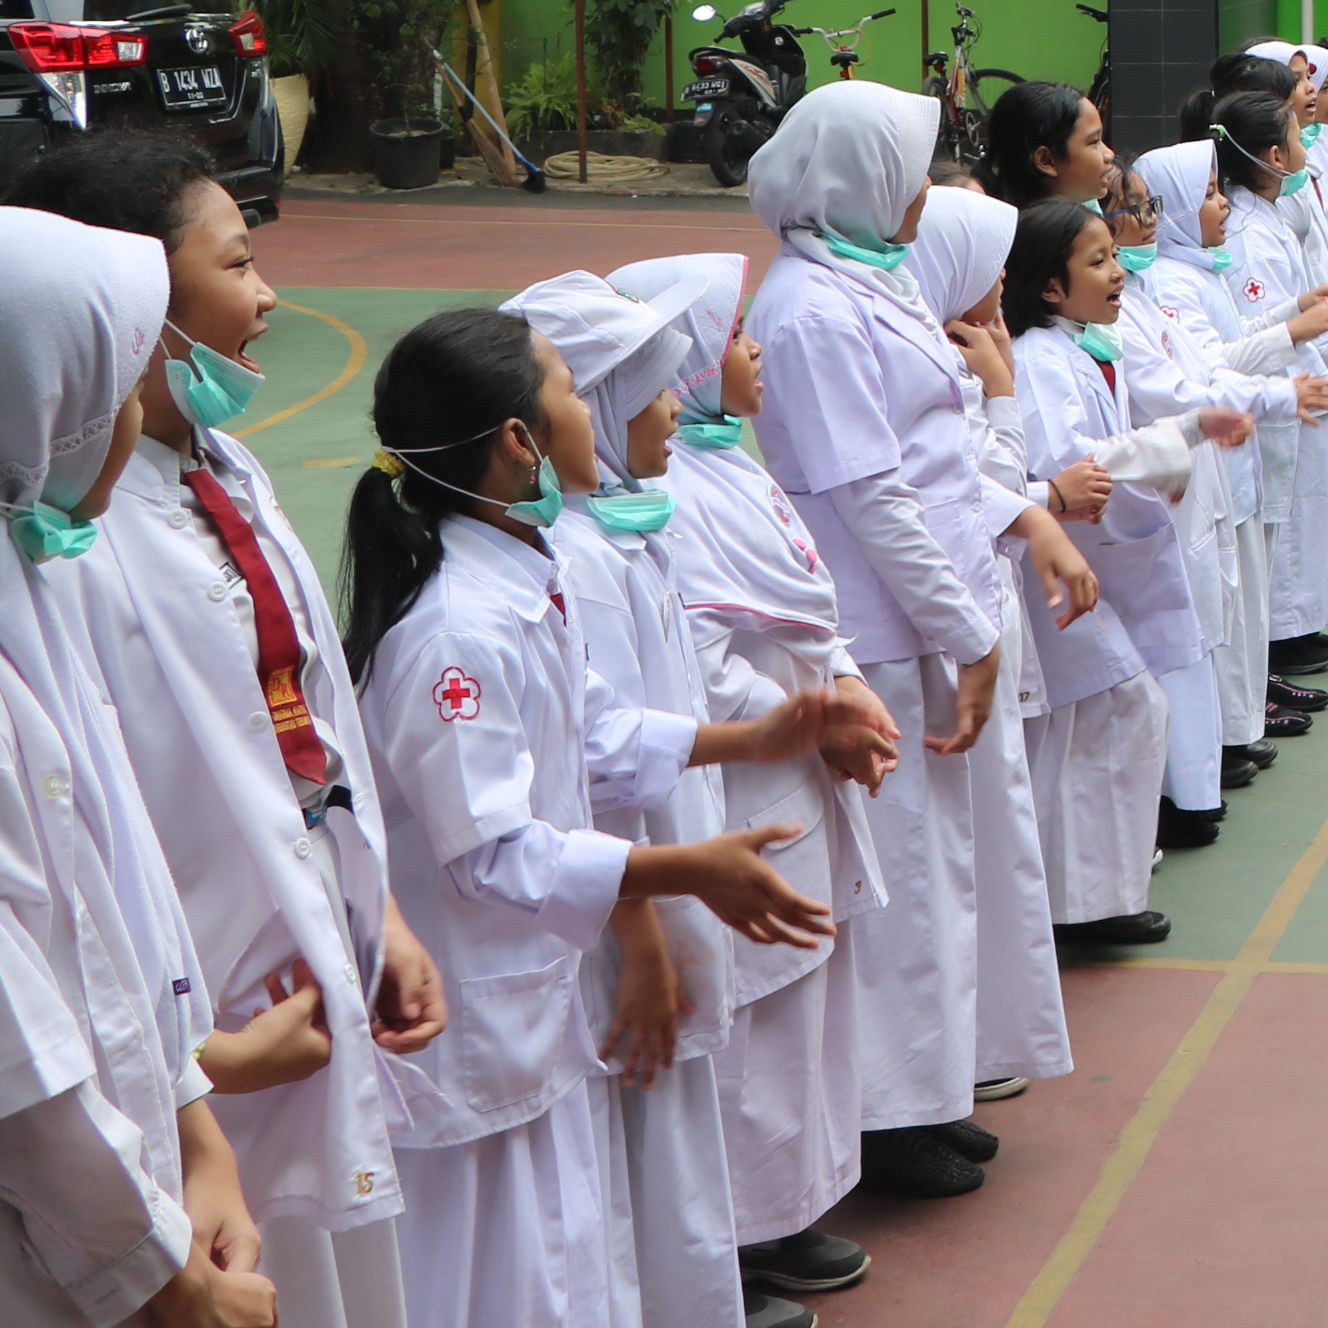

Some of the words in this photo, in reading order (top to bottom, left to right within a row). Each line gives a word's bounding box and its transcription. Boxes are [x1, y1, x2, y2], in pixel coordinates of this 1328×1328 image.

[160, 72, 170, 92] B
[174, 70, 198, 91] 1434
[354, 1171, 375, 1195] 15
